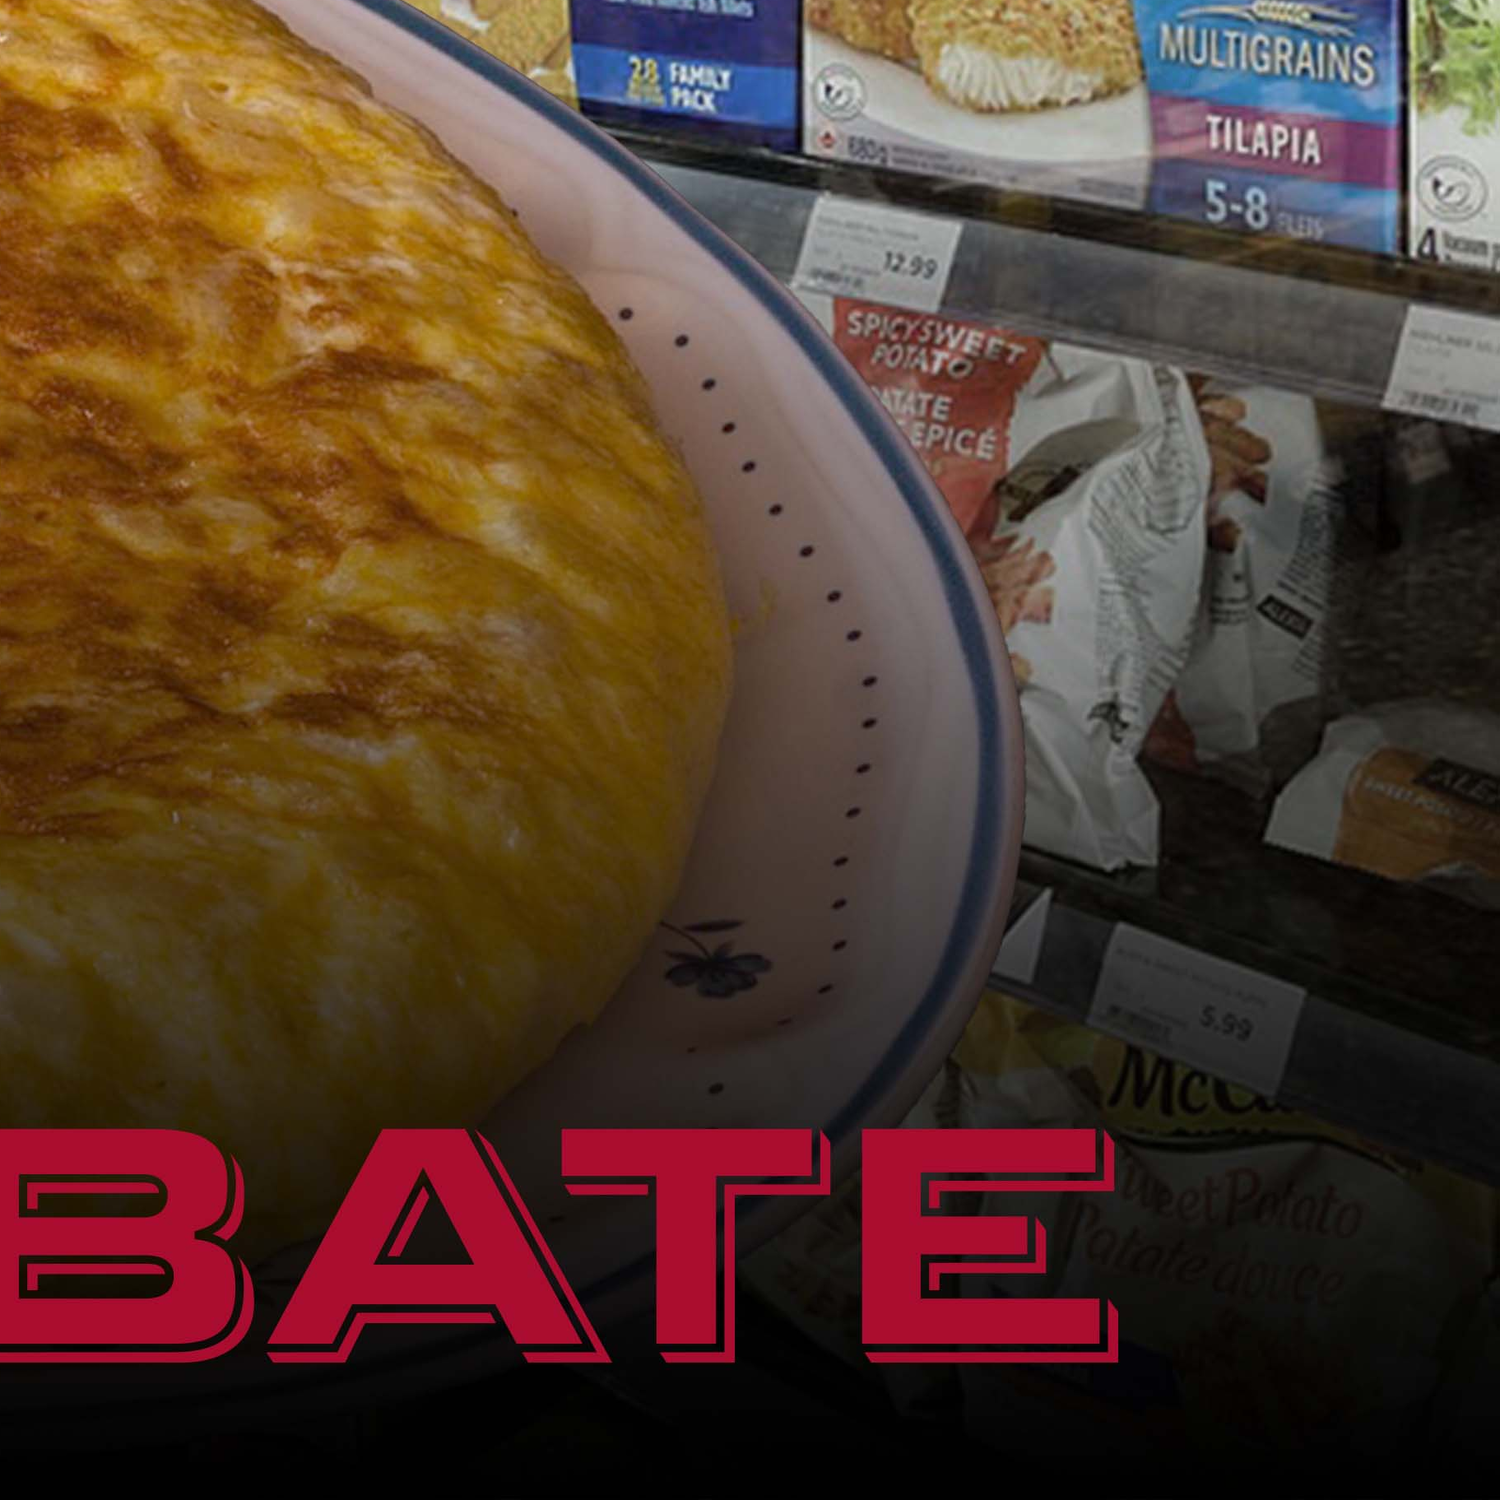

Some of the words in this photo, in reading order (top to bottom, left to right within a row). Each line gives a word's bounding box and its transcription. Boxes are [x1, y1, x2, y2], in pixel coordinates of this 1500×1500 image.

[1159, 21, 1376, 88] MULTIGRAINS
[669, 61, 732, 91] FAMILY
[671, 86, 717, 113] PACK
[1206, 113, 1322, 166] TILAPIA
[1204, 178, 1269, 230] 5-8
[883, 250, 938, 281] 12.99
[870, 343, 974, 380] POTATO
[918, 320, 1028, 365] SWEET
[1197, 1003, 1255, 1042] 5.99
